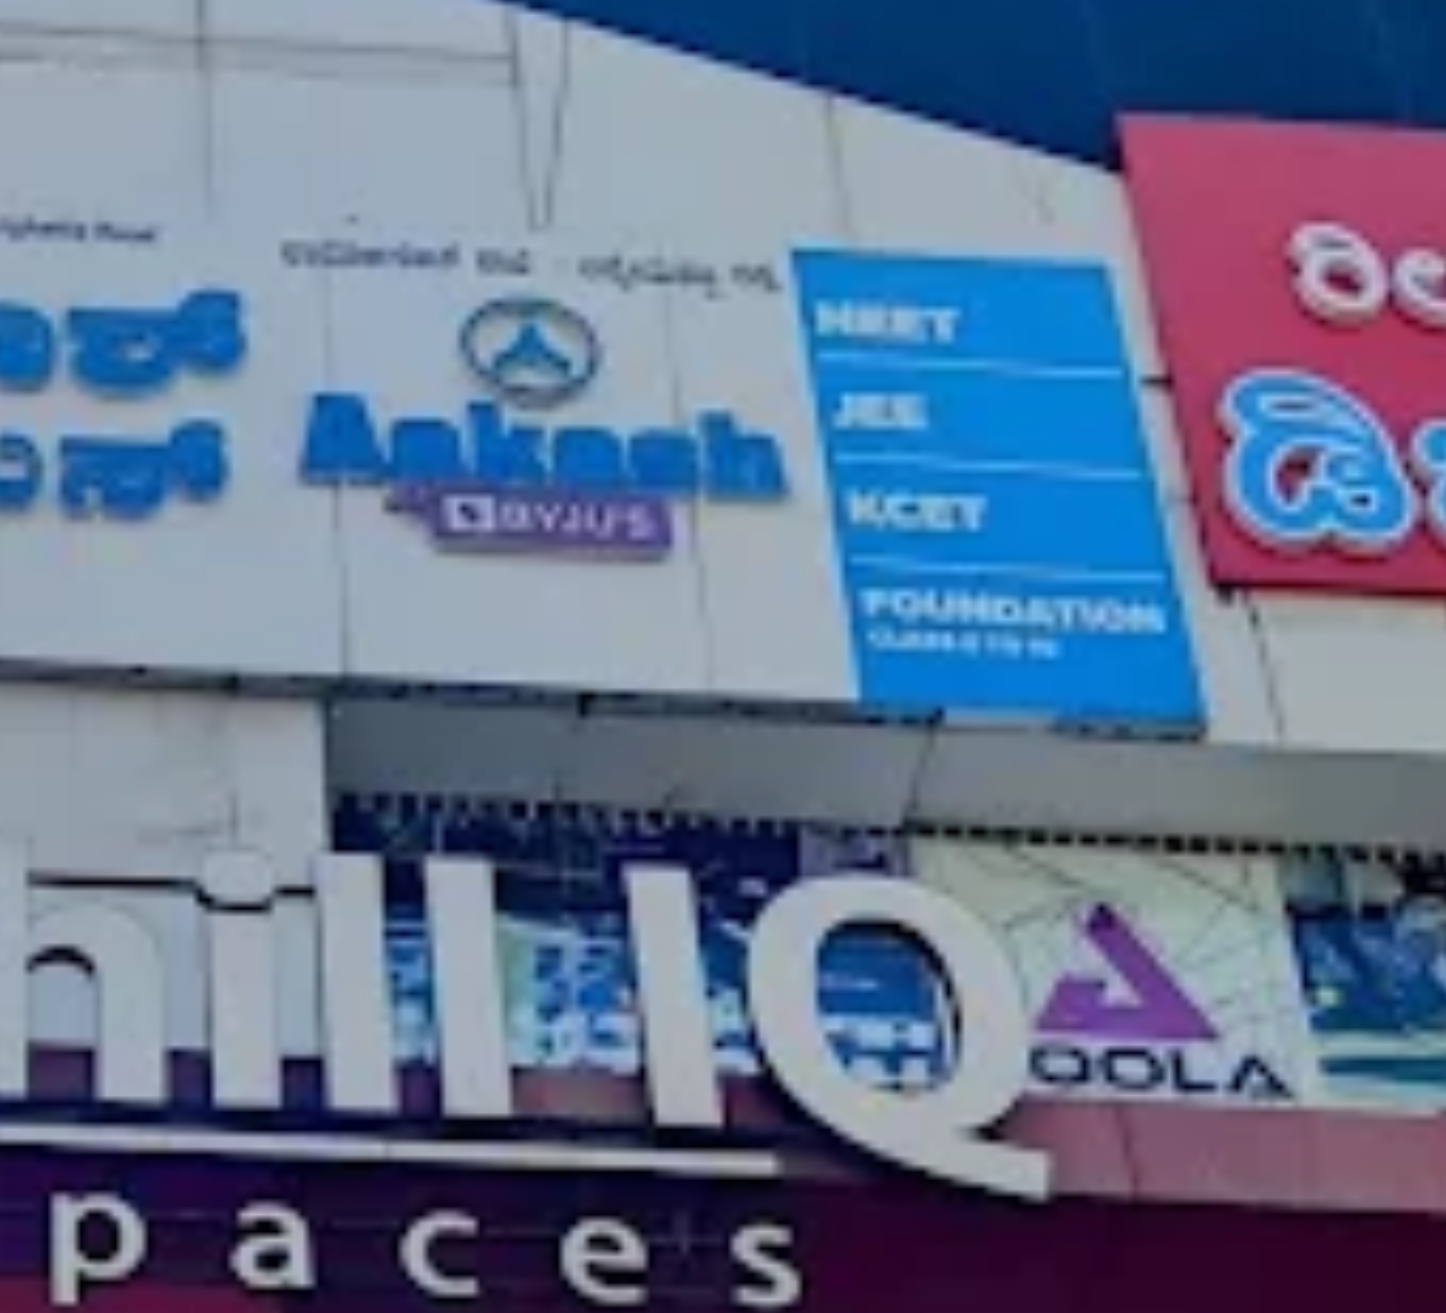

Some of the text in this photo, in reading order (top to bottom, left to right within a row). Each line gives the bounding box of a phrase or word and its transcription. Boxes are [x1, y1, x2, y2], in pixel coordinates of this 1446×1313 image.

[813, 300, 961, 345] NEET
[833, 392, 929, 431] JEE
[300, 392, 790, 504] Aakash
[846, 489, 986, 533] KCET
[859, 588, 1167, 634] FOUNDATION
[622, 864, 1052, 1202] IQ
[1027, 1045, 1296, 1099] OOLA
